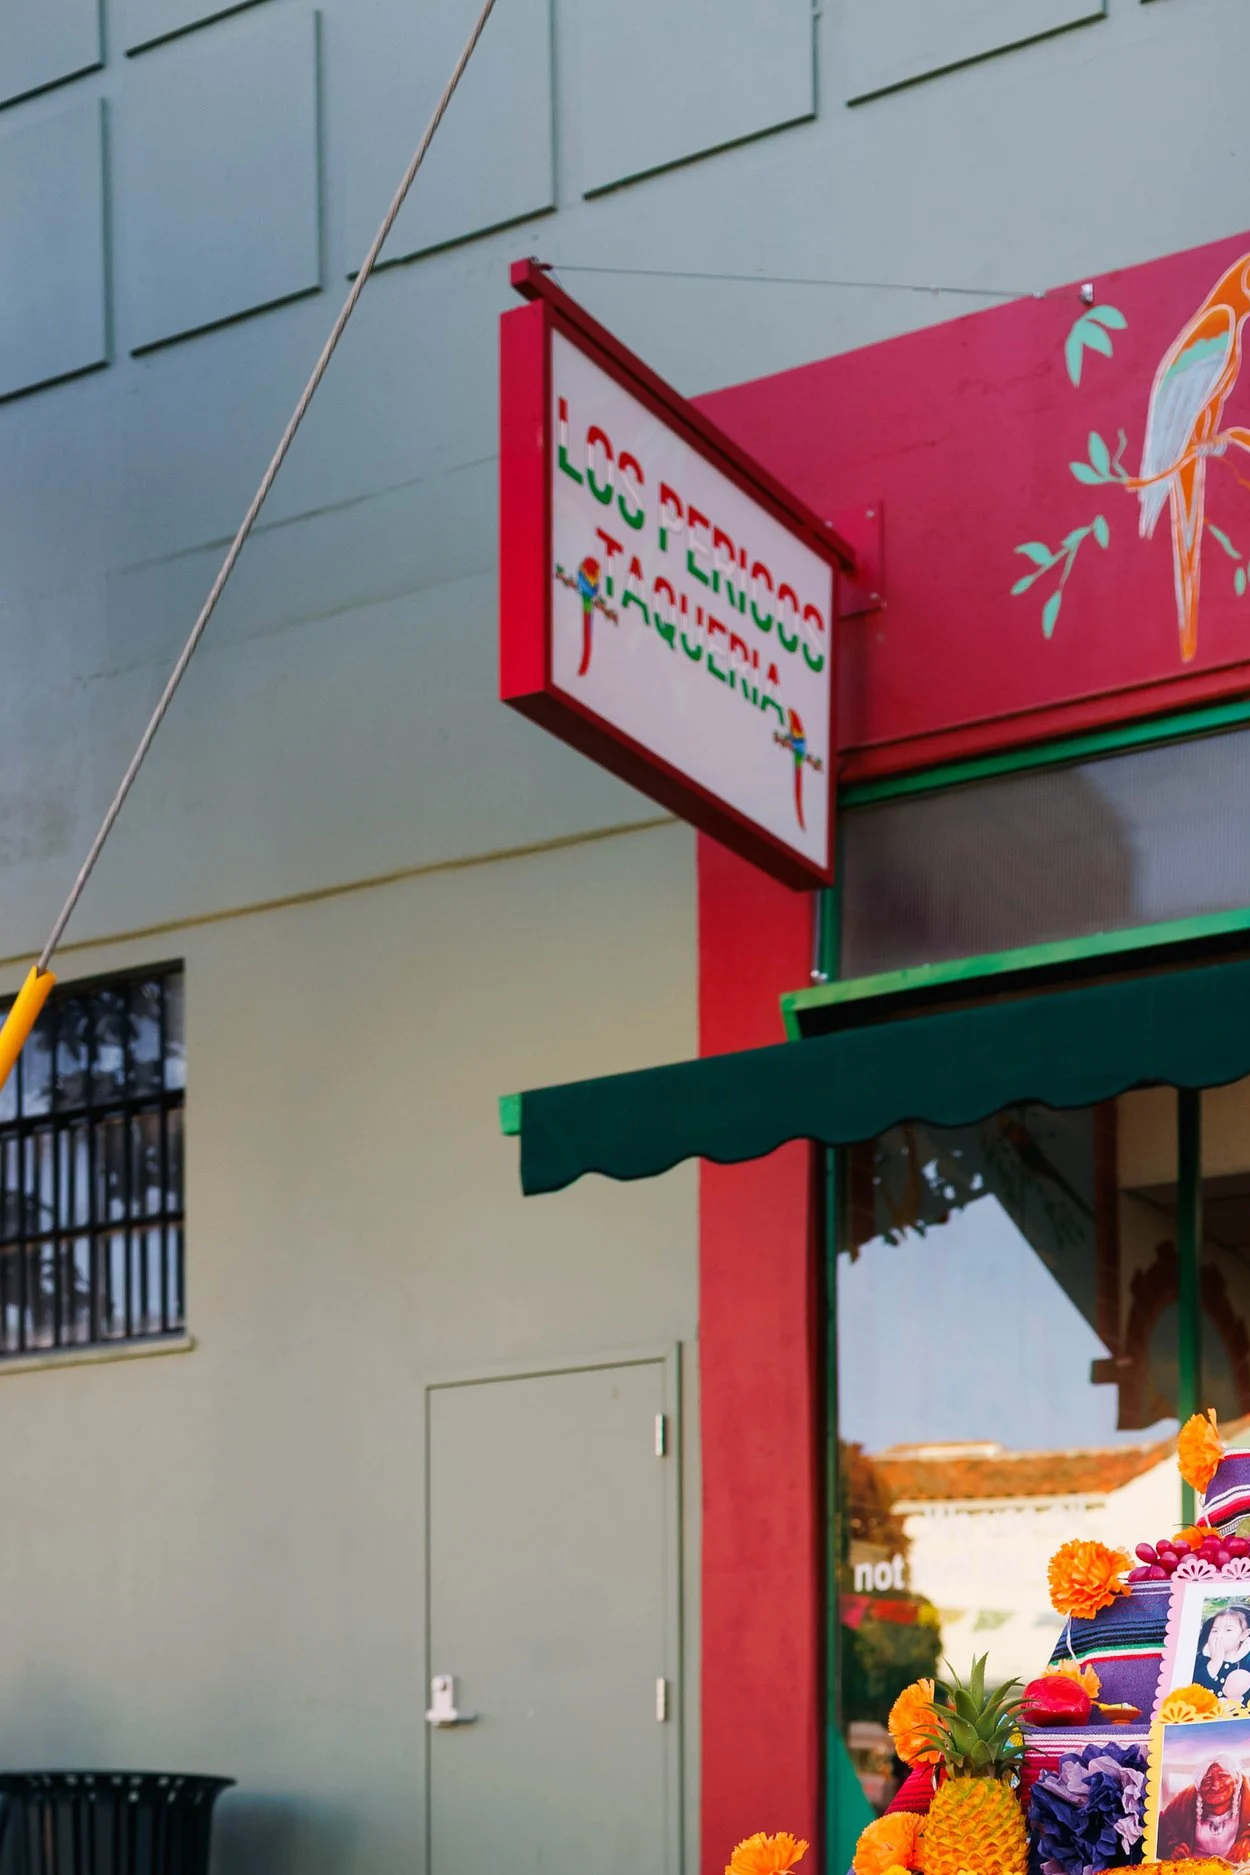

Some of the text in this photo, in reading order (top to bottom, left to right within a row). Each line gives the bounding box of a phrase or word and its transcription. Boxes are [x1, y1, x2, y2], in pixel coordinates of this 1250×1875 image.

[556, 395, 826, 673] LOS PERICOS
[595, 528, 786, 726] TAQUERIA
[853, 1552, 907, 1592] not
